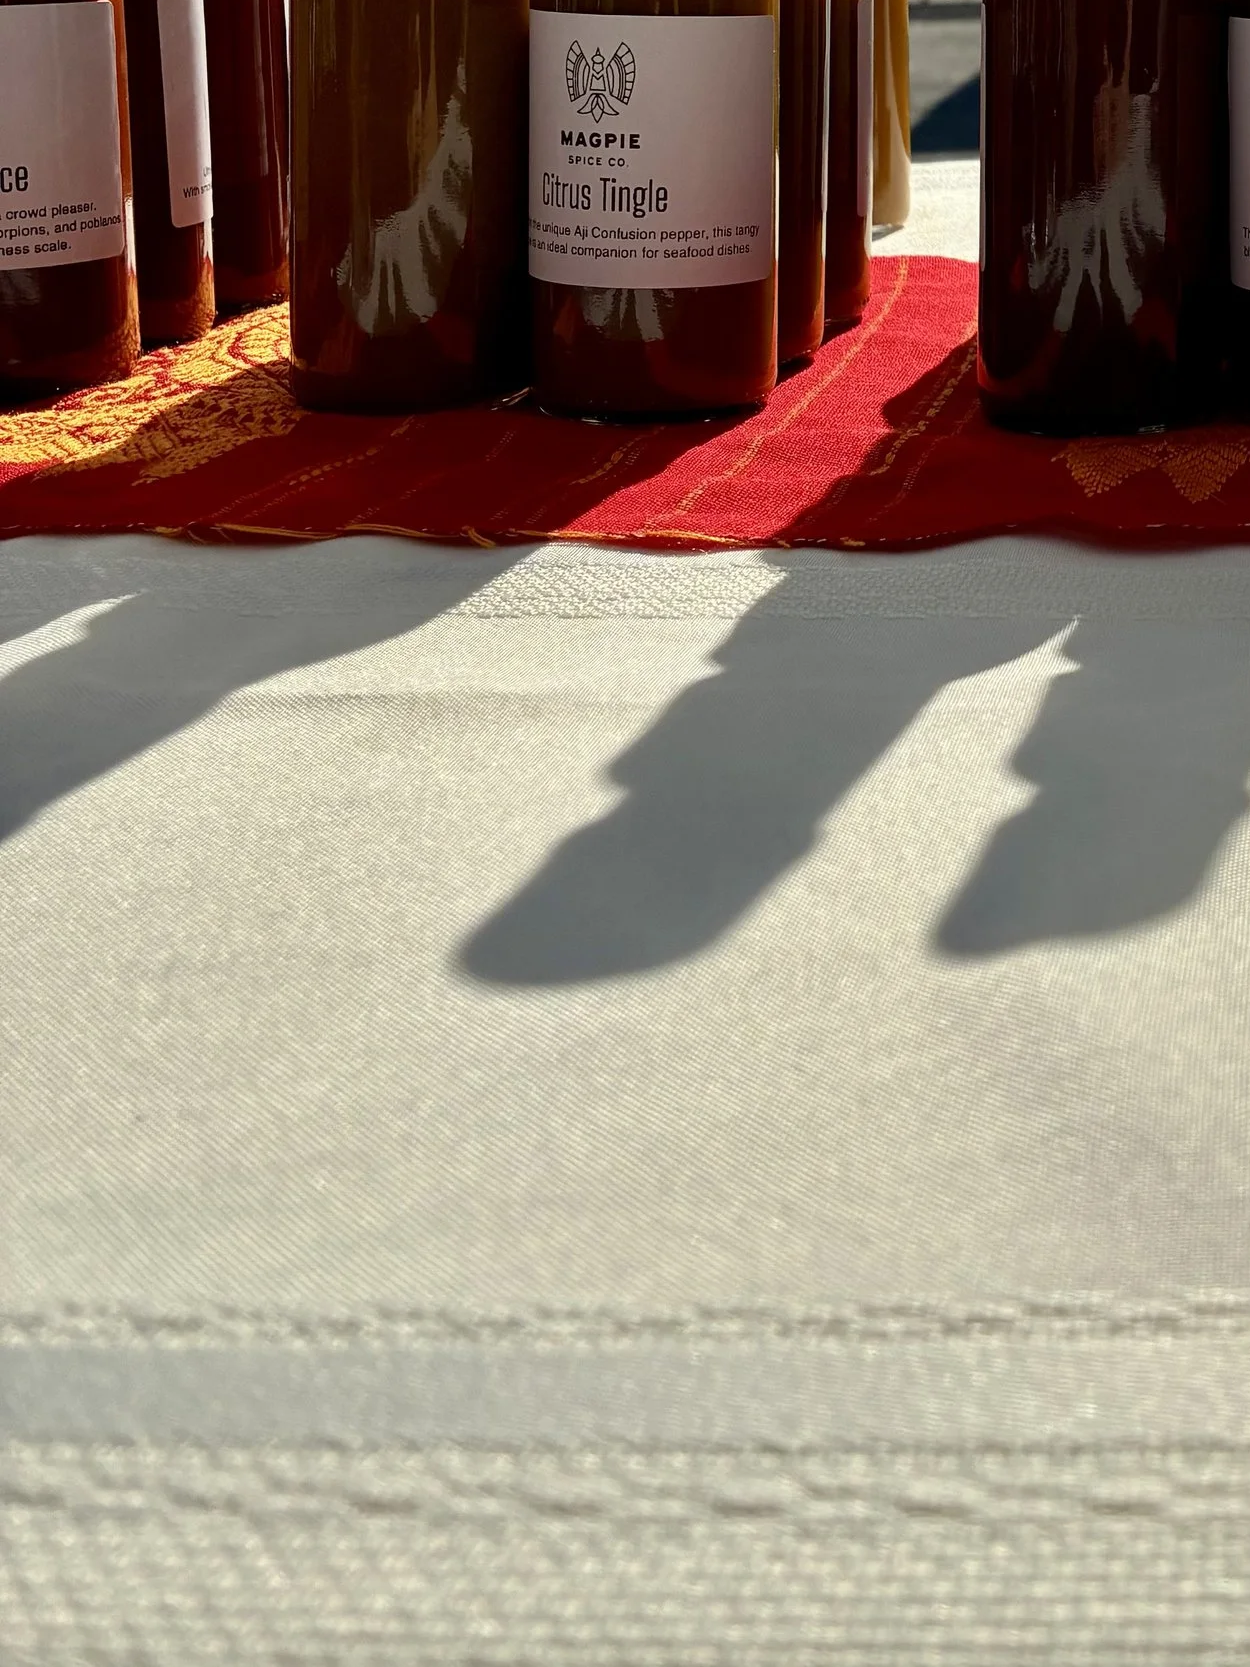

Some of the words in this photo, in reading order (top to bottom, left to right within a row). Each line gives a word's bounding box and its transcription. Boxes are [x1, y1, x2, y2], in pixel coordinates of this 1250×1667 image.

[560, 130, 641, 149] MAGPIE
[568, 155, 602, 166] SPICE
[608, 157, 629, 168] CO.
[542, 172, 591, 210] Citrus
[599, 177, 668, 218] Tingle
[6, 206, 47, 220] crowd
[51, 202, 97, 219] pleaser.
[54, 220, 77, 234] and
[80, 214, 121, 232] poblanos
[542, 222, 571, 237] unique
[573, 225, 589, 240] Aji
[591, 226, 656, 240] Confusion
[660, 229, 709, 242] pepper,
[712, 225, 732, 238] this
[735, 224, 760, 237] tangy
[34, 240, 72, 253] scale.
[546, 240, 568, 254] ideal
[570, 246, 637, 259] companion
[642, 246, 659, 259] for
[663, 245, 714, 259] seafood
